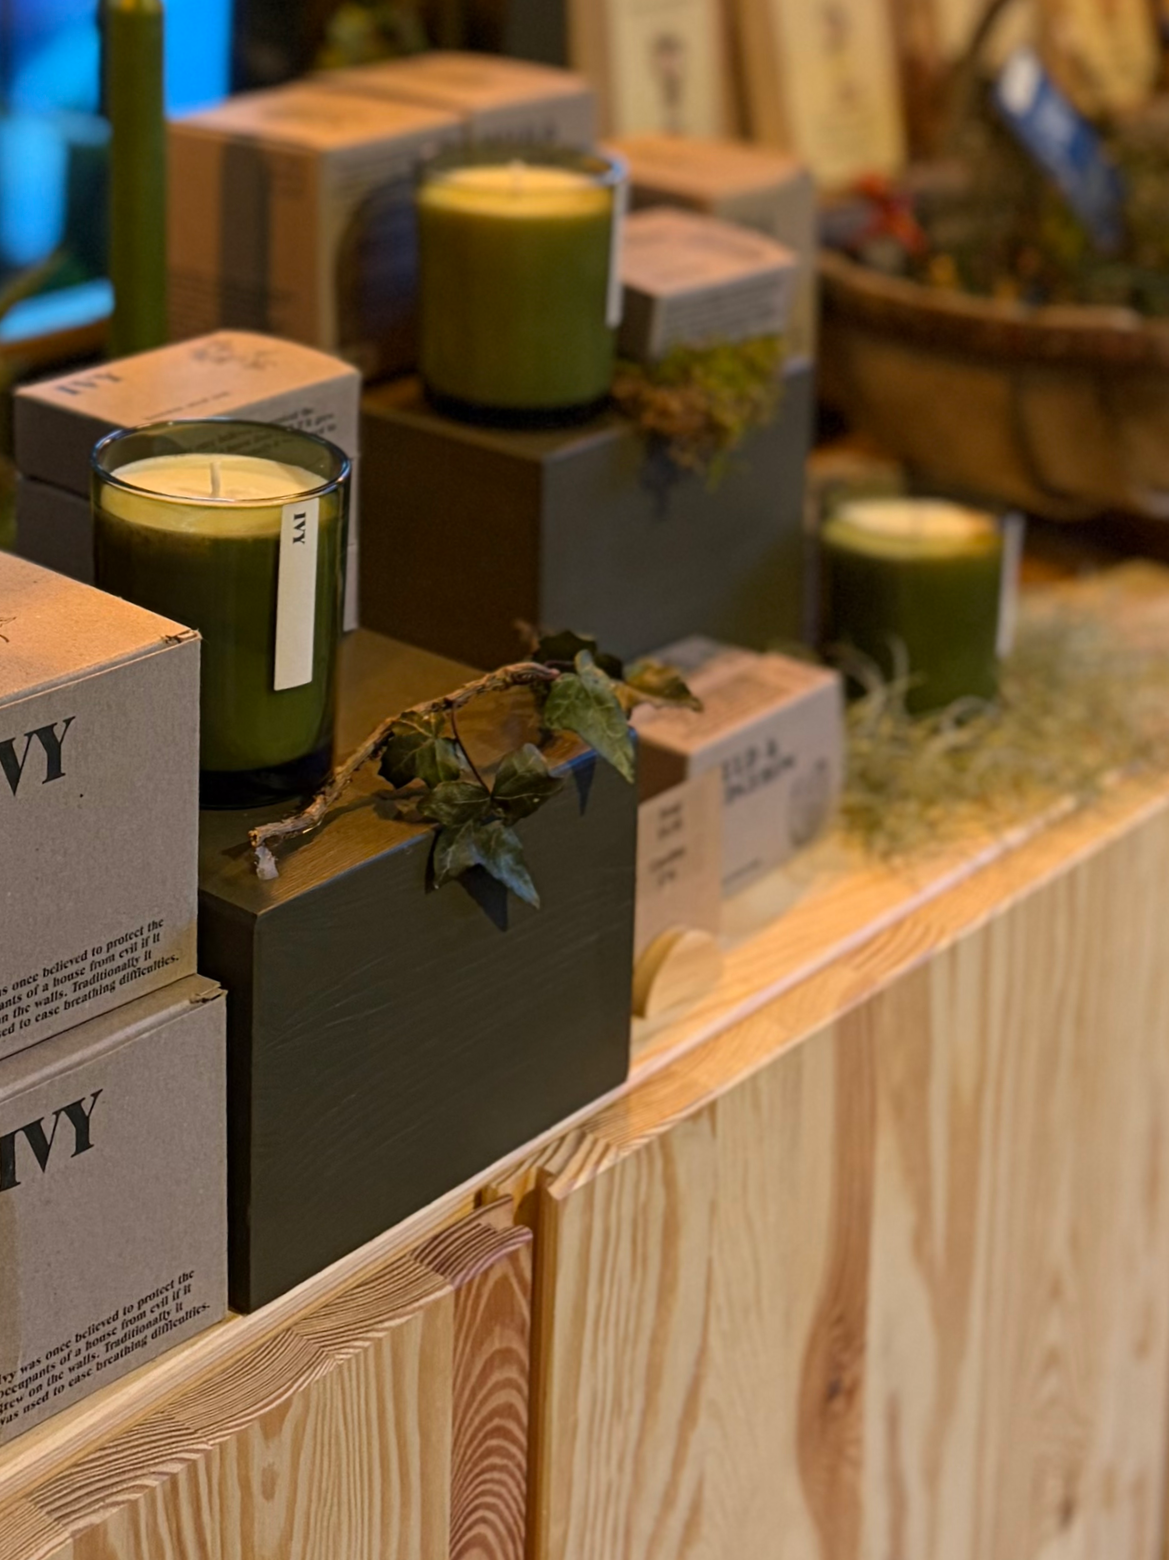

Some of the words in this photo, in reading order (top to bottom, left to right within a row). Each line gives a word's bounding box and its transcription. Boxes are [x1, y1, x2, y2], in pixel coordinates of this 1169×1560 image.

[293, 512, 306, 544] IVY
[12, 973, 39, 991] once
[42, 949, 88, 978] believed
[91, 946, 103, 957] to
[106, 926, 144, 954] protect
[147, 919, 164, 933] the
[13, 1004, 31, 1019] the
[34, 990, 68, 1008] walls.
[72, 956, 141, 993] Traditionally
[144, 950, 152, 961] it
[26, 984, 40, 999] of
[42, 983, 49, 993] a
[53, 967, 86, 988] house
[90, 953, 115, 972] from
[118, 941, 138, 959] evil
[141, 935, 150, 949] if
[152, 932, 160, 944] it
[19, 1018, 31, 1030] to
[35, 1006, 60, 1023] ease
[63, 980, 116, 1011] breathing
[20, 1357, 42, 1374] was
[45, 1340, 72, 1360] once
[75, 1309, 119, 1343] believed
[123, 1304, 134, 1316] to
[137, 1279, 174, 1311] protect
[178, 1270, 195, 1285] the
[28, 1383, 43, 1398] on
[47, 1371, 64, 1387] the
[68, 1352, 100, 1373] walls.
[104, 1309, 172, 1353] Traditionally
[175, 1302, 183, 1313] it
[59, 1349, 73, 1366] of
[74, 1348, 81, 1357] a
[85, 1327, 117, 1351] house
[121, 1310, 146, 1331] from
[150, 1295, 168, 1314] evil
[172, 1288, 181, 1302] if
[183, 1283, 191, 1295] it
[23, 1390, 49, 1414] used
[53, 1384, 65, 1396] to
[68, 1368, 92, 1387] ease
[96, 1335, 148, 1371] breathing
